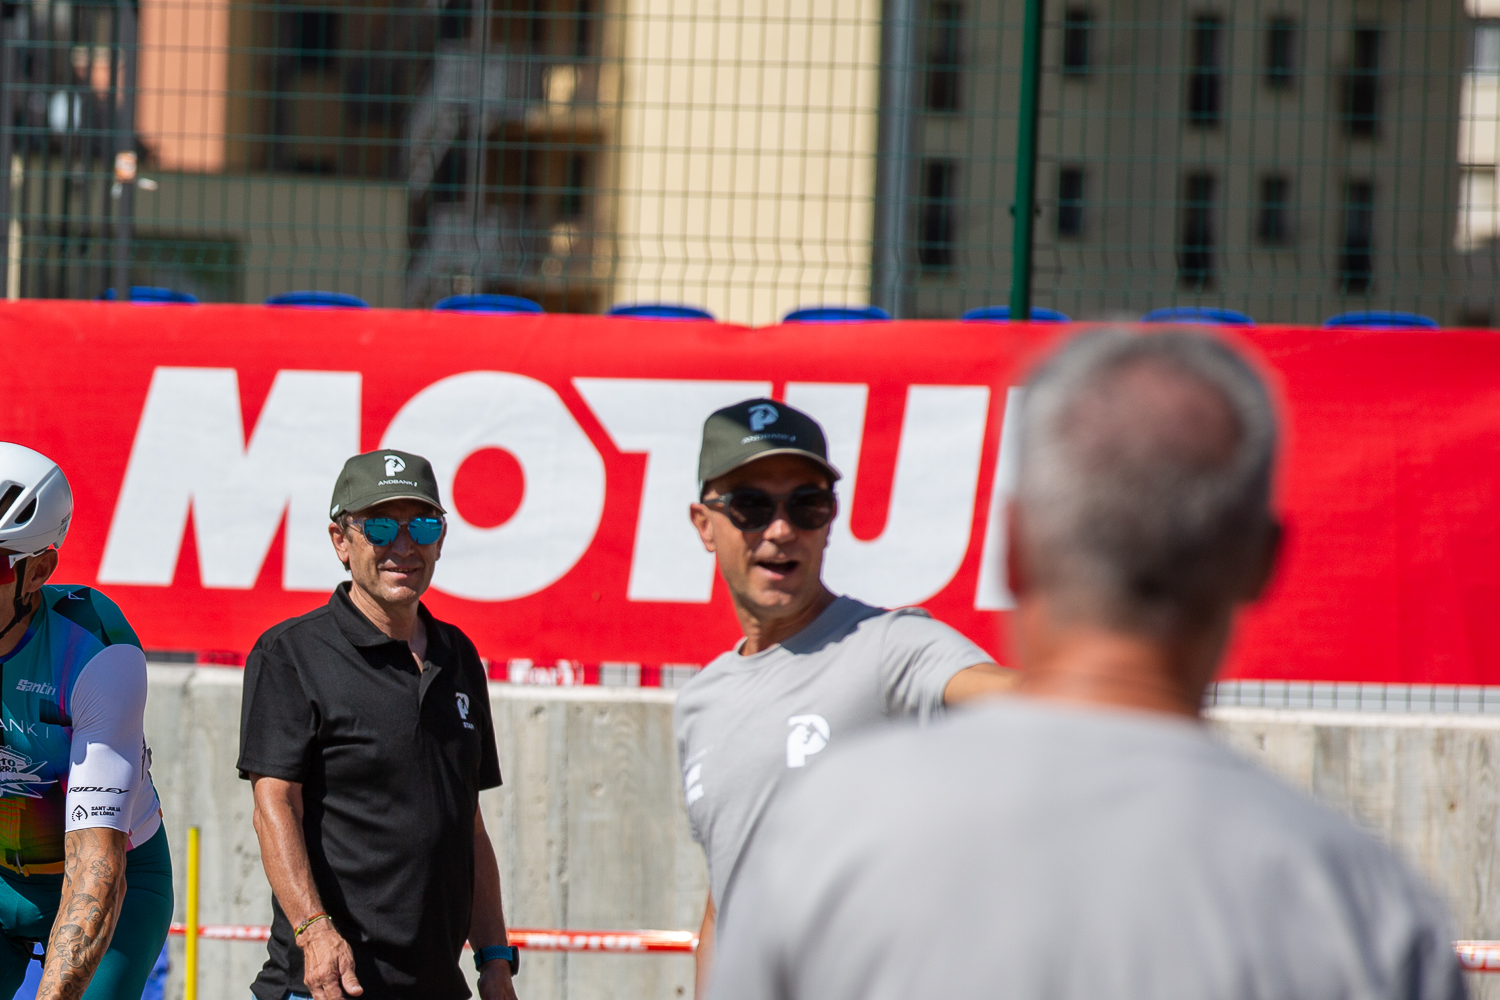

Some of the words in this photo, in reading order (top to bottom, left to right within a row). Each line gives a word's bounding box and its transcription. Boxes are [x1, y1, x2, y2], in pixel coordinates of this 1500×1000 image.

[100, 364, 1022, 612] MOTU
[16, 679, 58, 696] Santini
[68, 786, 130, 795] RIDLEY
